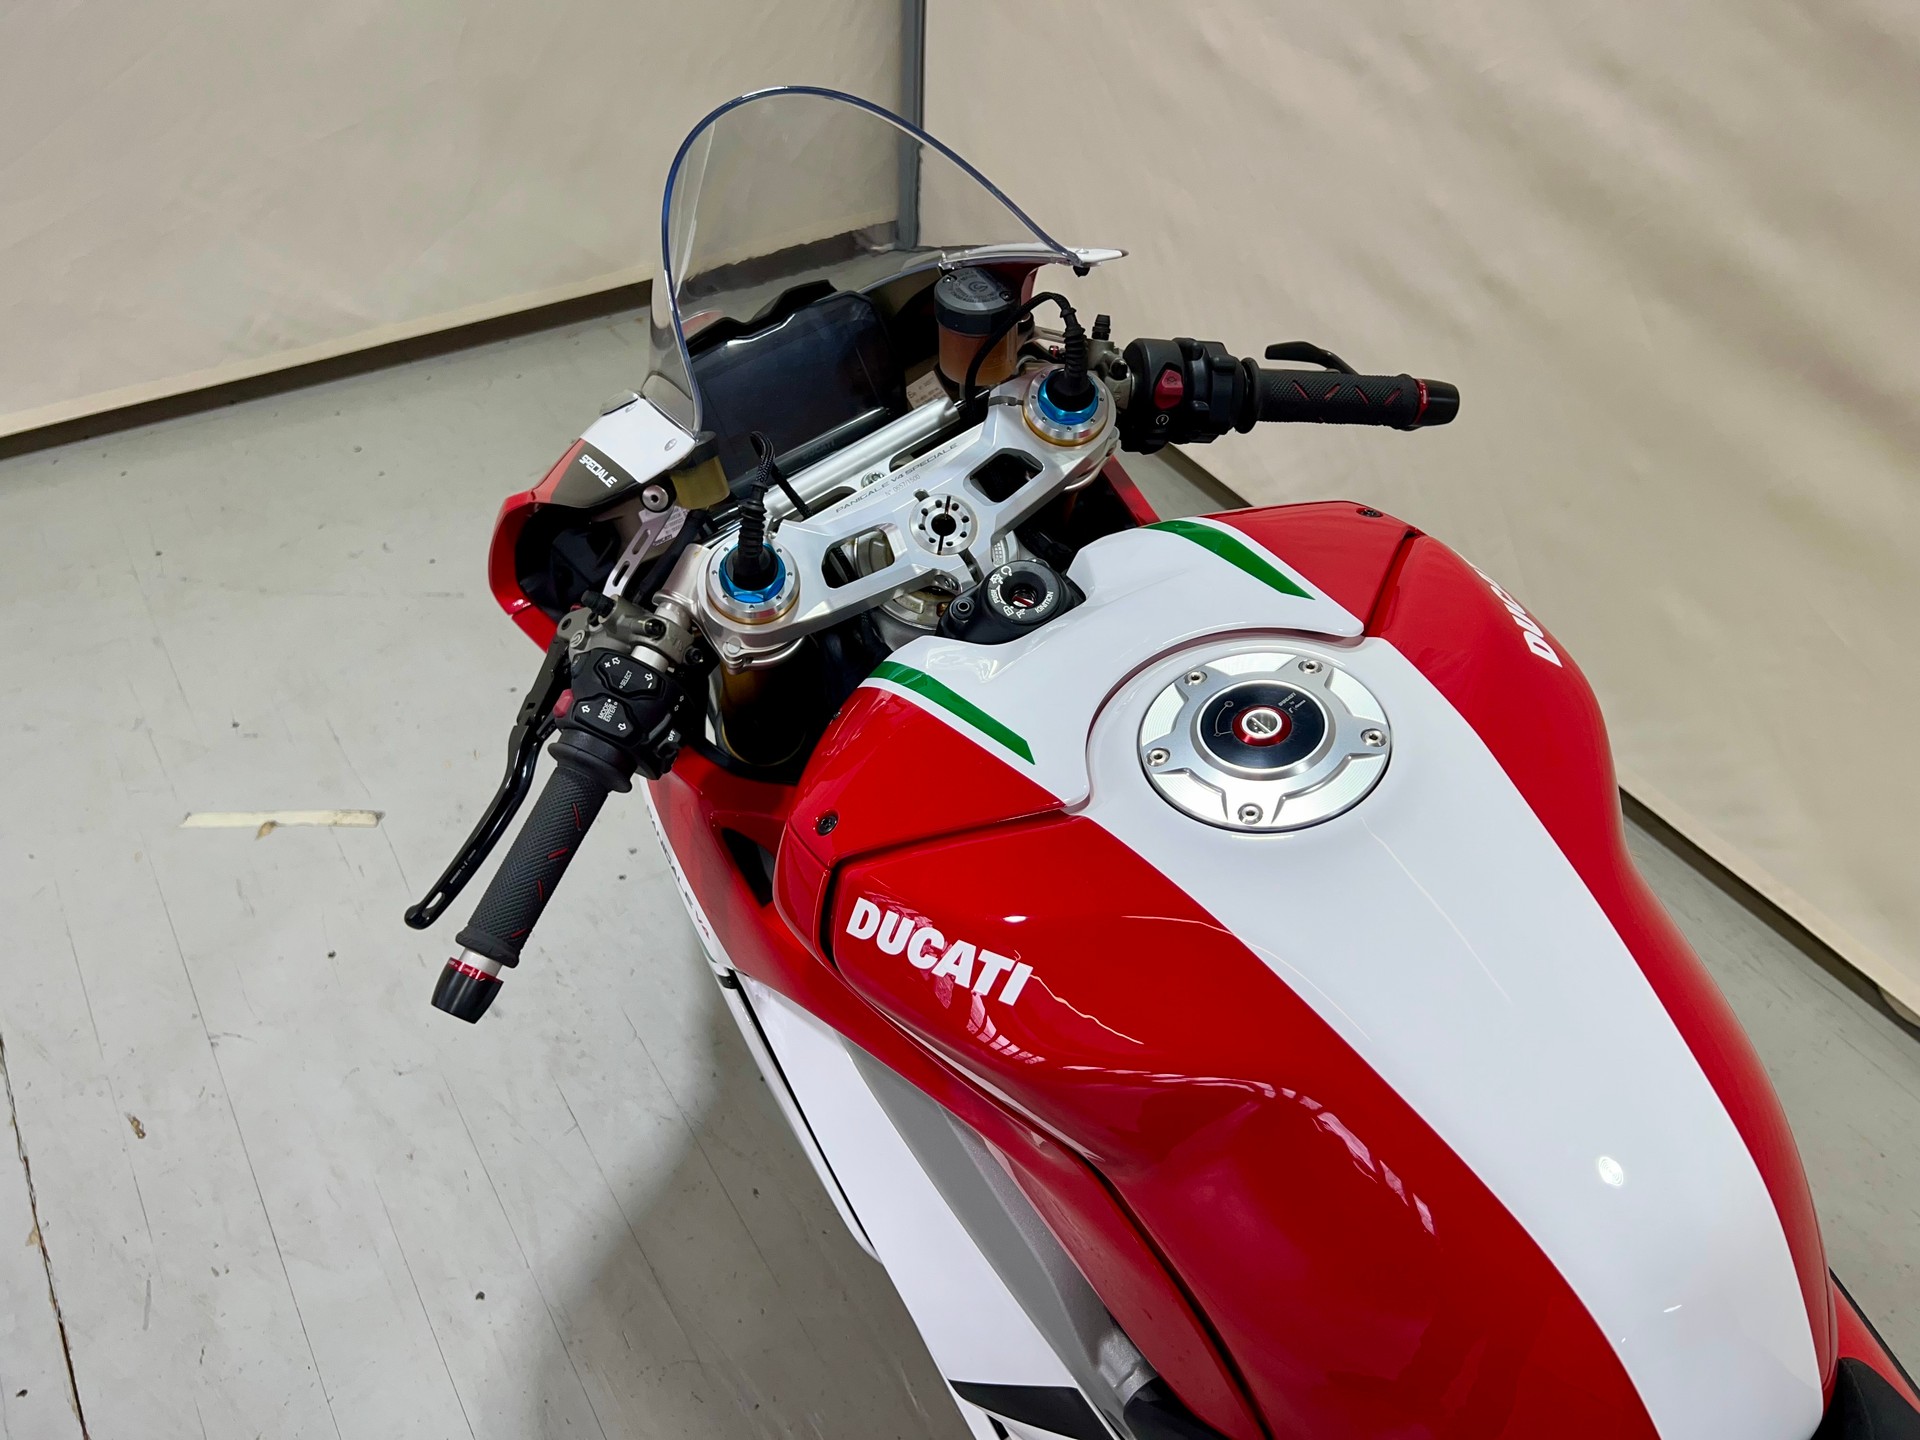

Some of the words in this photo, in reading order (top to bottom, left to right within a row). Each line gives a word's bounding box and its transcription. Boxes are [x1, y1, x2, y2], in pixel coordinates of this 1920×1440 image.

[578, 454, 618, 488] SPECIALE
[836, 482, 890, 513] PANIGALE
[891, 473, 904, 483] V4
[905, 442, 958, 475] SPECIALE
[1034, 591, 1054, 613] IGNITION
[622, 670, 633, 687] SELECT
[598, 702, 610, 719] MODE
[603, 704, 618, 723] ENTER
[845, 896, 1034, 1007] DUCATI
